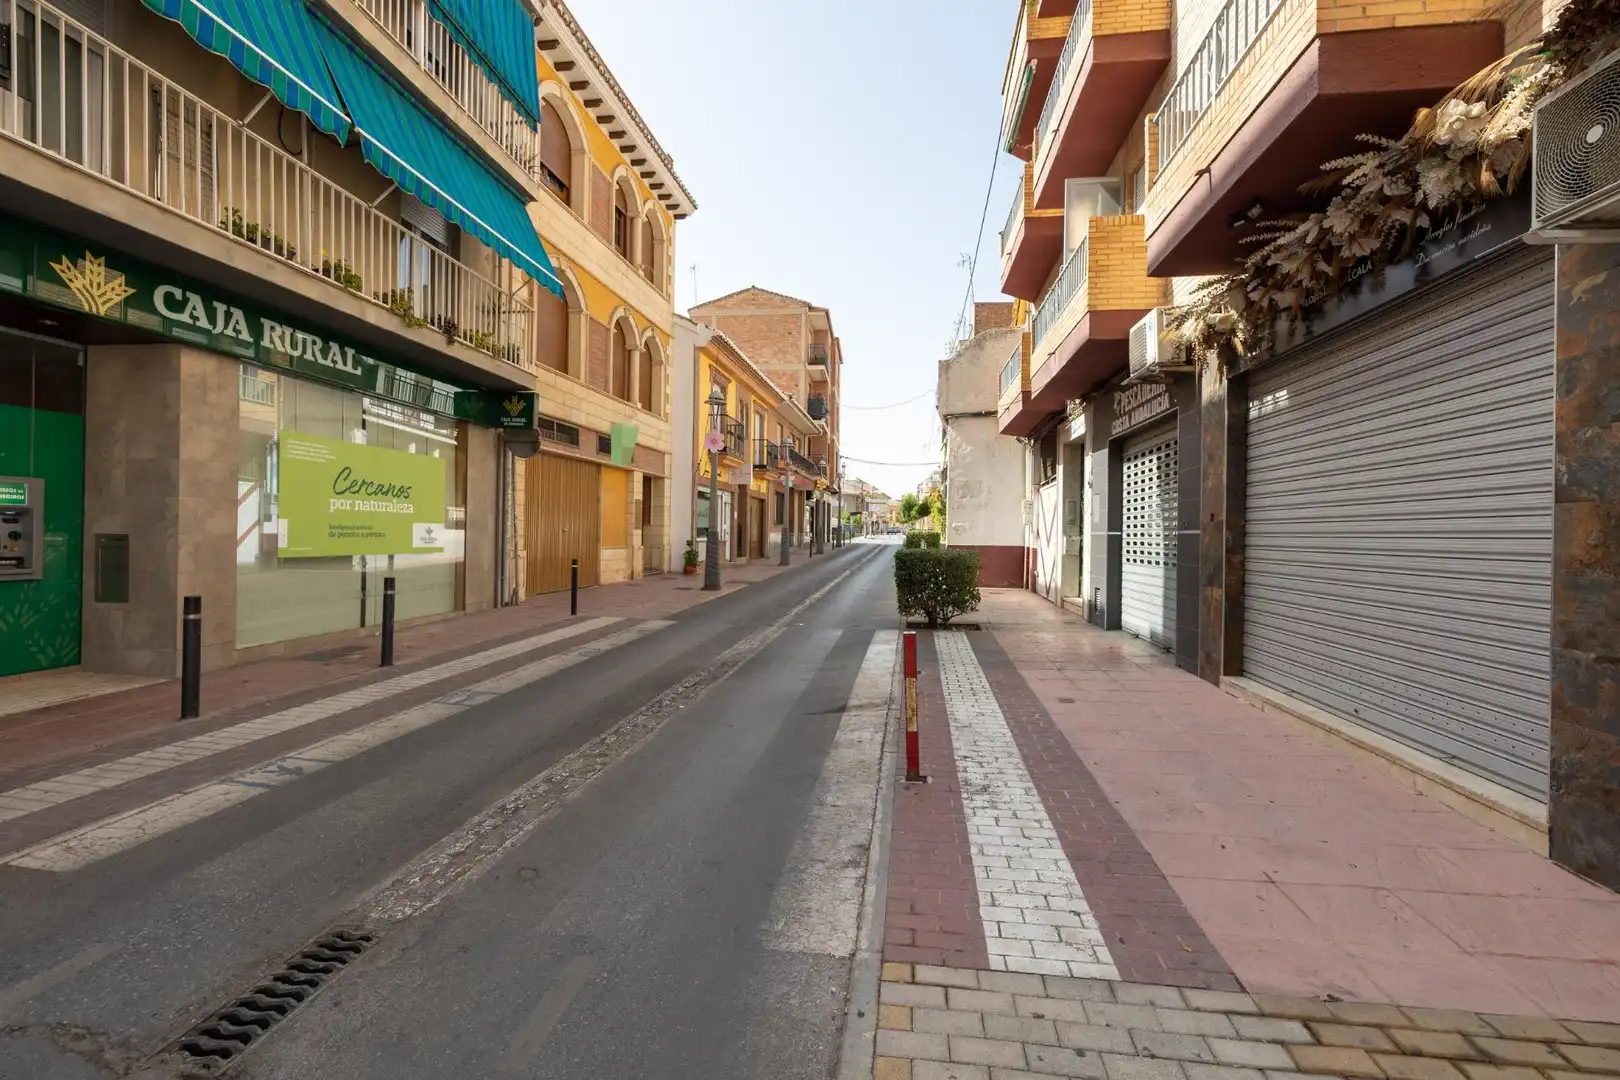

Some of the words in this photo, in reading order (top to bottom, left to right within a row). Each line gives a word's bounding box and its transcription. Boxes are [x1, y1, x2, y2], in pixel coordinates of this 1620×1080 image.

[153, 284, 254, 343] CAJA
[259, 316, 362, 376] RURAL
[333, 466, 413, 499] Cercanos
[329, 498, 353, 514] por
[354, 500, 414, 514] naturaleza
